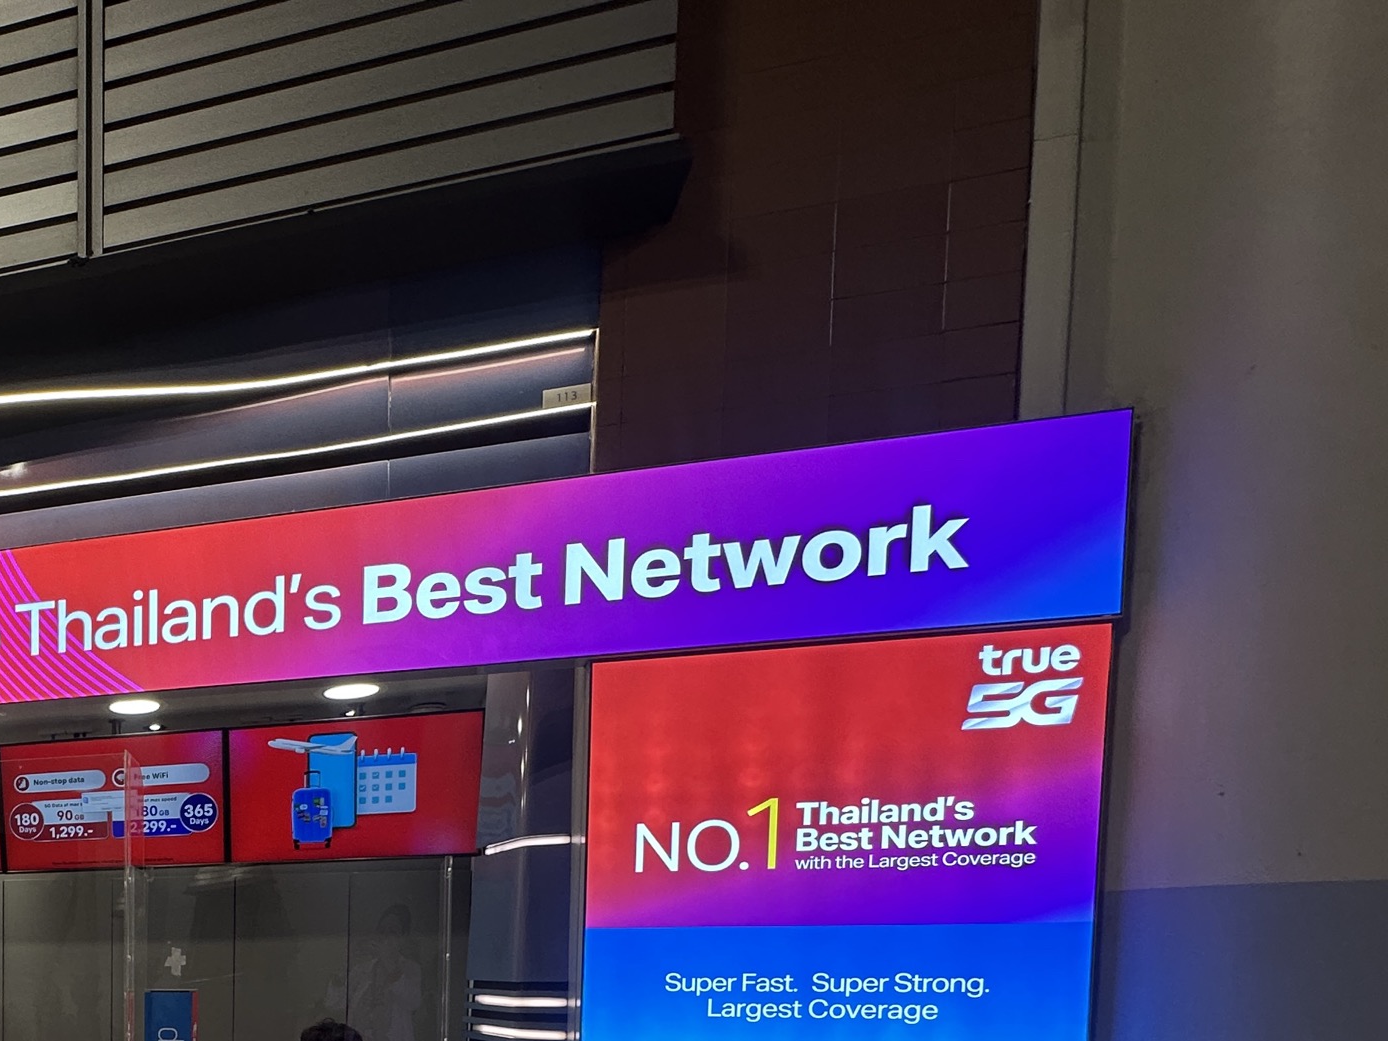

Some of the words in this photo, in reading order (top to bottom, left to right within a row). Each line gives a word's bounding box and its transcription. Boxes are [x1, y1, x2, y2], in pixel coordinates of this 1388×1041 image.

[557, 391, 577, 402] 113
[15, 573, 341, 657] Thailand's
[362, 552, 543, 625] Best
[564, 504, 970, 606] Network
[979, 644, 1080, 676] true
[961, 677, 1084, 730] 5G
[33, 778, 68, 786] Non-stop
[69, 776, 85, 785] data
[152, 771, 169, 779] WiFi
[14, 814, 40, 826] 180
[57, 810, 72, 821] 90
[184, 804, 213, 817] 365
[796, 796, 974, 826] Thailand's
[49, 825, 94, 839] 1,299.-
[796, 826, 873, 852] Best
[881, 820, 1038, 850] Network
[795, 855, 833, 870] with
[834, 853, 864, 869] the
[869, 852, 939, 871] Largest
[941, 850, 1036, 868] Coverage
[665, 973, 737, 996] Super
[742, 973, 798, 993] Fast.
[811, 972, 889, 998] Super
[893, 973, 990, 998] Strong.
[707, 999, 802, 1022] Largest
[808, 999, 938, 1023] Coverage
